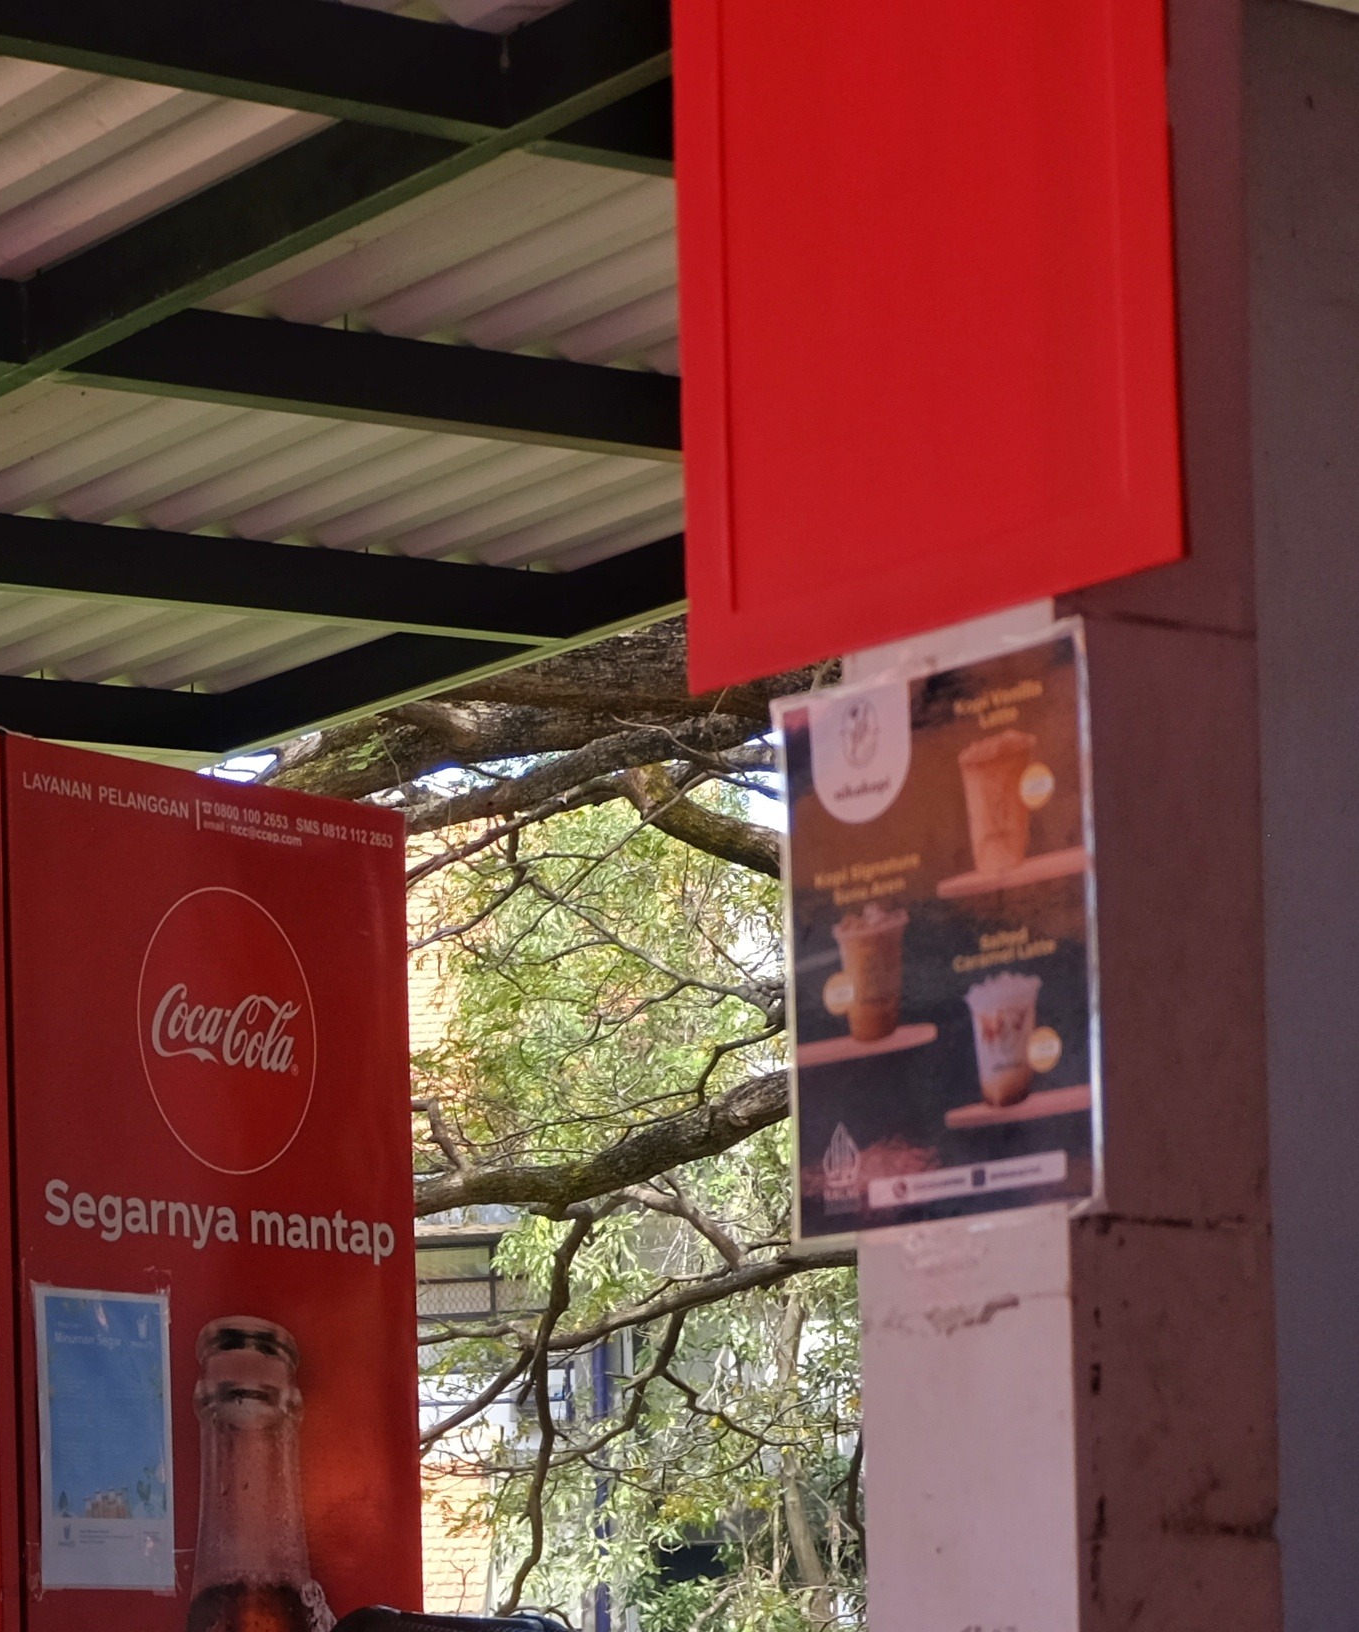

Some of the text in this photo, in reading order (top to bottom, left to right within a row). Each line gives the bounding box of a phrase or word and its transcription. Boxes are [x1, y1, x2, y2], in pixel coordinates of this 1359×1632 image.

[22, 771, 394, 849] LAYANAN PELANGGAN 0800 100 2653 SMS 0812 112 2653
[152, 983, 301, 1073] Coca-Cola
[44, 1179, 395, 1265] Segarnya mantap
